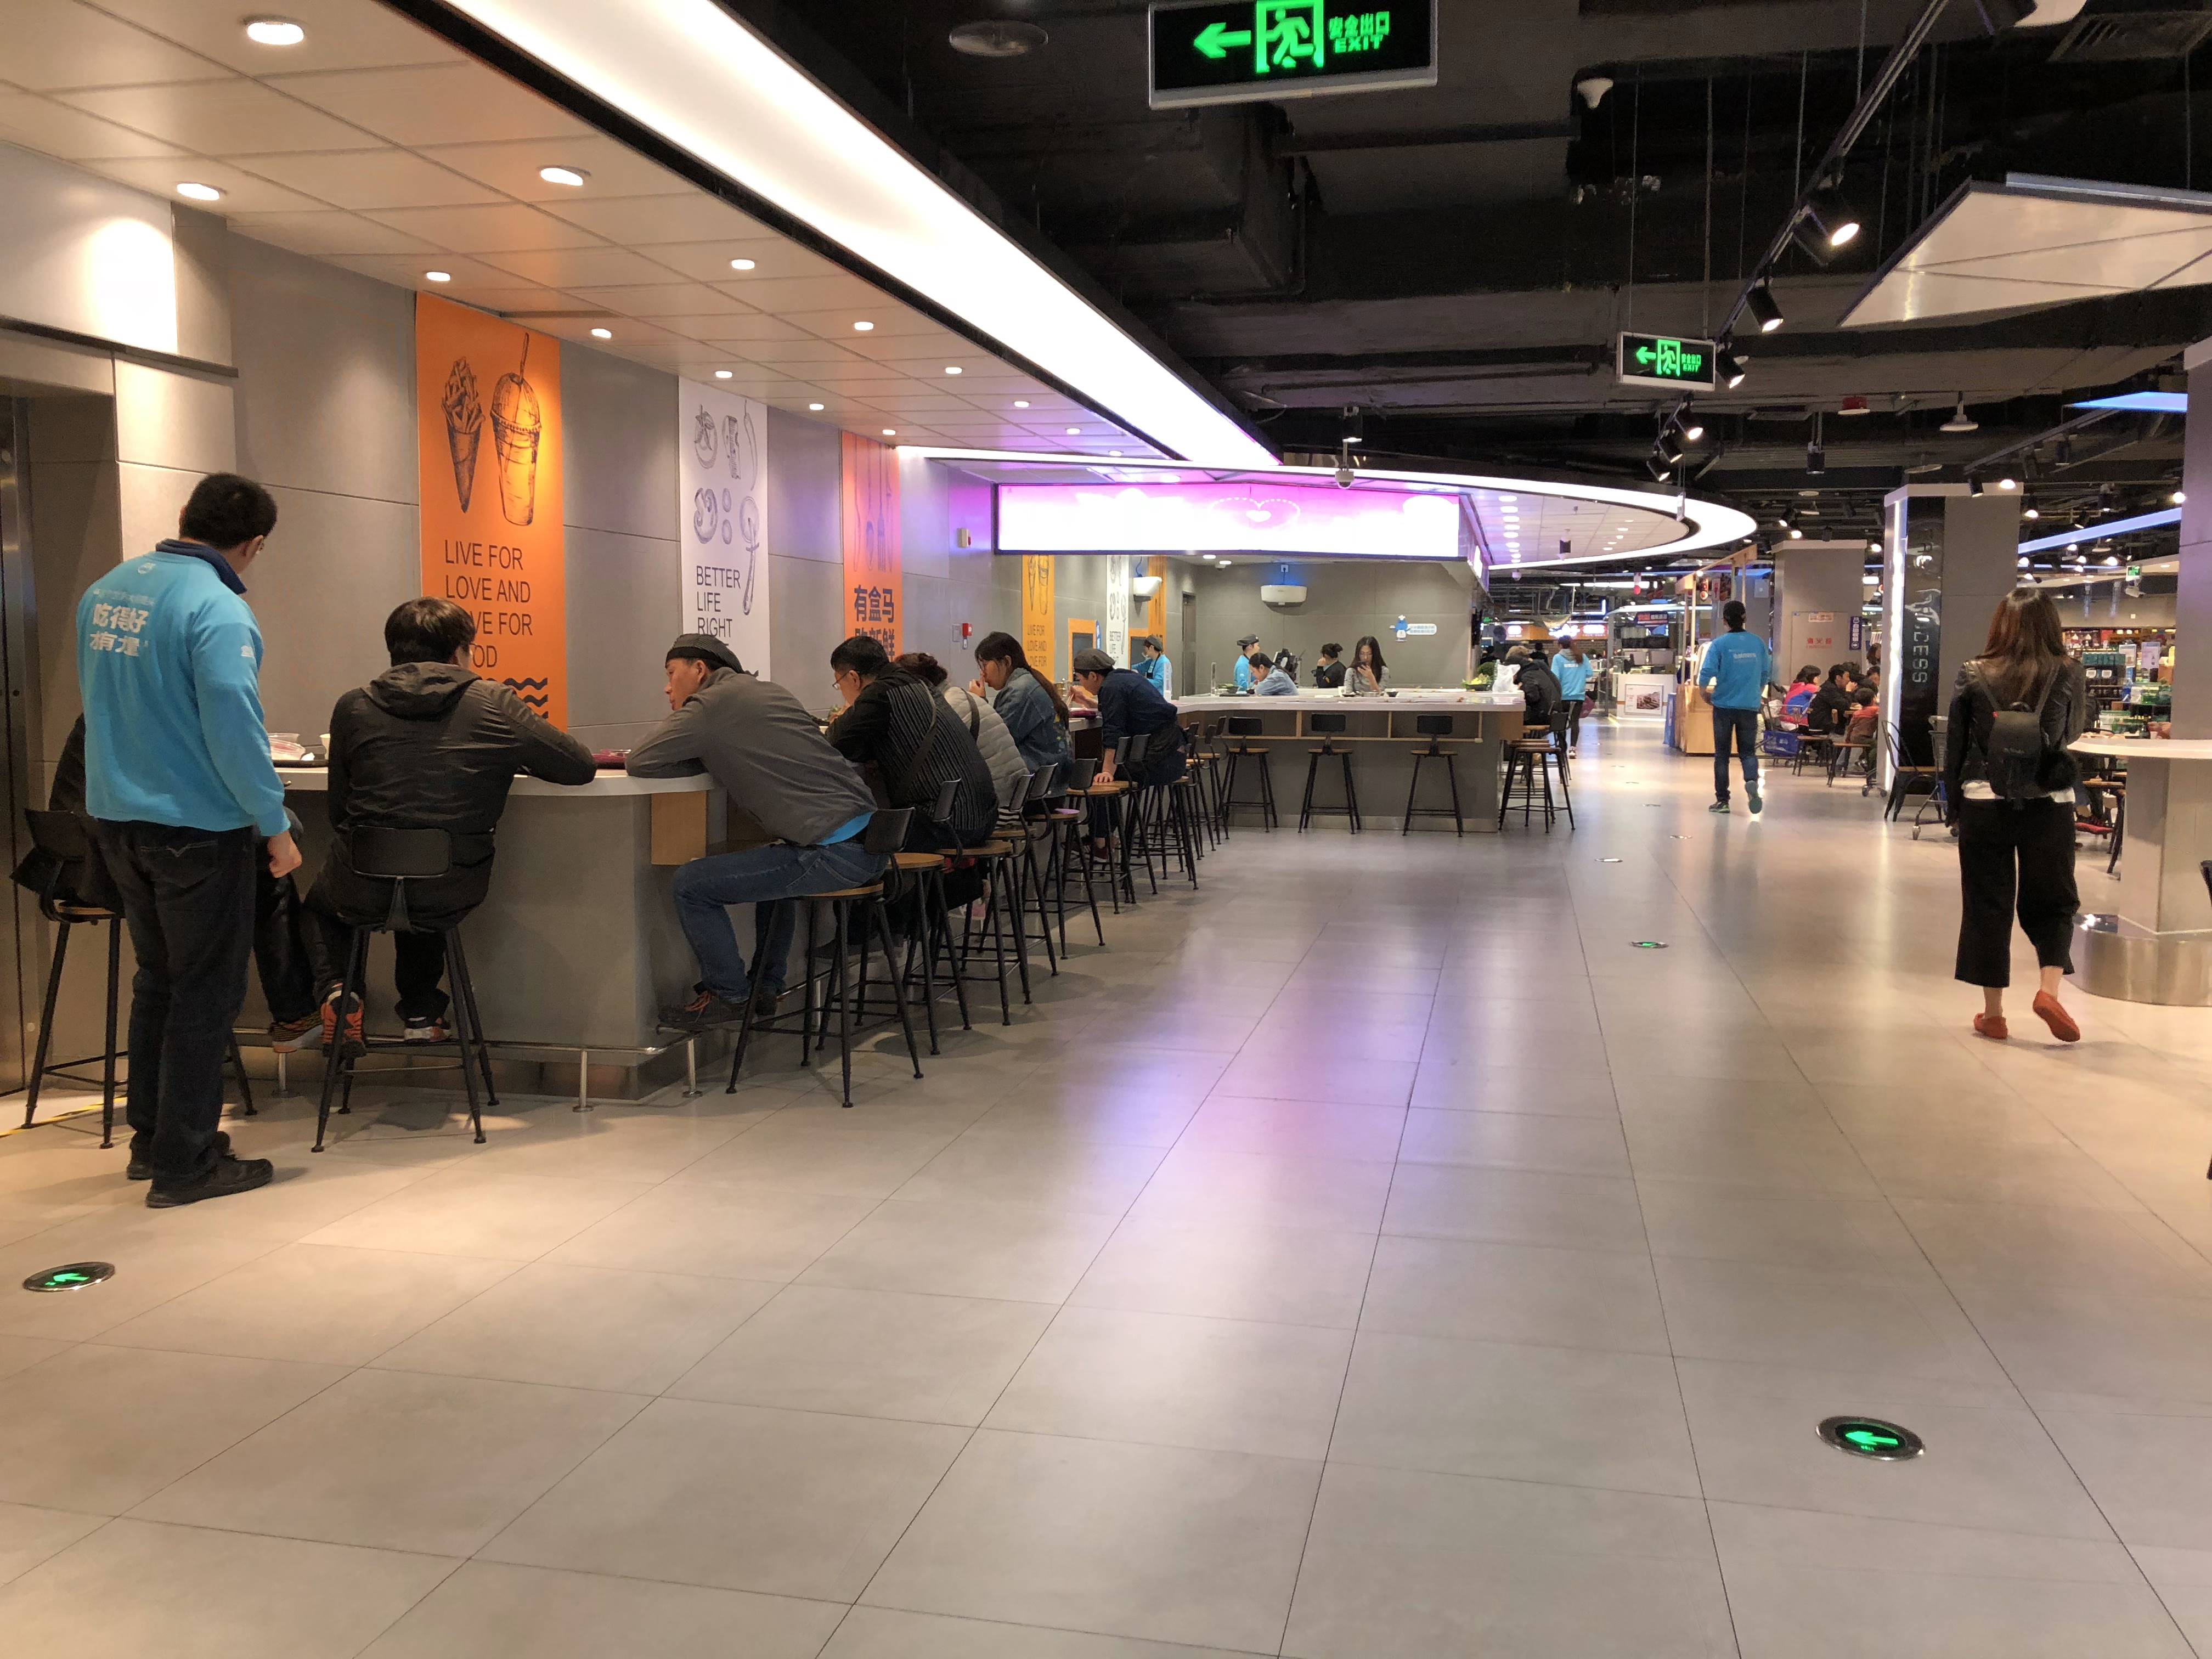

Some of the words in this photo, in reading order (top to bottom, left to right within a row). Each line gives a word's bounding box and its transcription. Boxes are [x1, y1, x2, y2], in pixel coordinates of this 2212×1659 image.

[1329, 12, 1389, 40] 安全出口
[1335, 35, 1383, 53] EXIT
[1683, 364, 1699, 372] EXIT
[445, 539, 483, 566] LIVE
[489, 545, 523, 570] FOR
[445, 575, 492, 601] LOVE
[496, 579, 531, 603] AND
[696, 565, 741, 589] BETTER
[697, 591, 721, 612] LIFE
[854, 584, 895, 623] 有盒马
[92, 603, 149, 633] 吃得好
[470, 611, 493, 635] VE
[499, 612, 533, 636] FOR
[697, 617, 732, 637] RIGHT
[472, 645, 498, 668] OD
